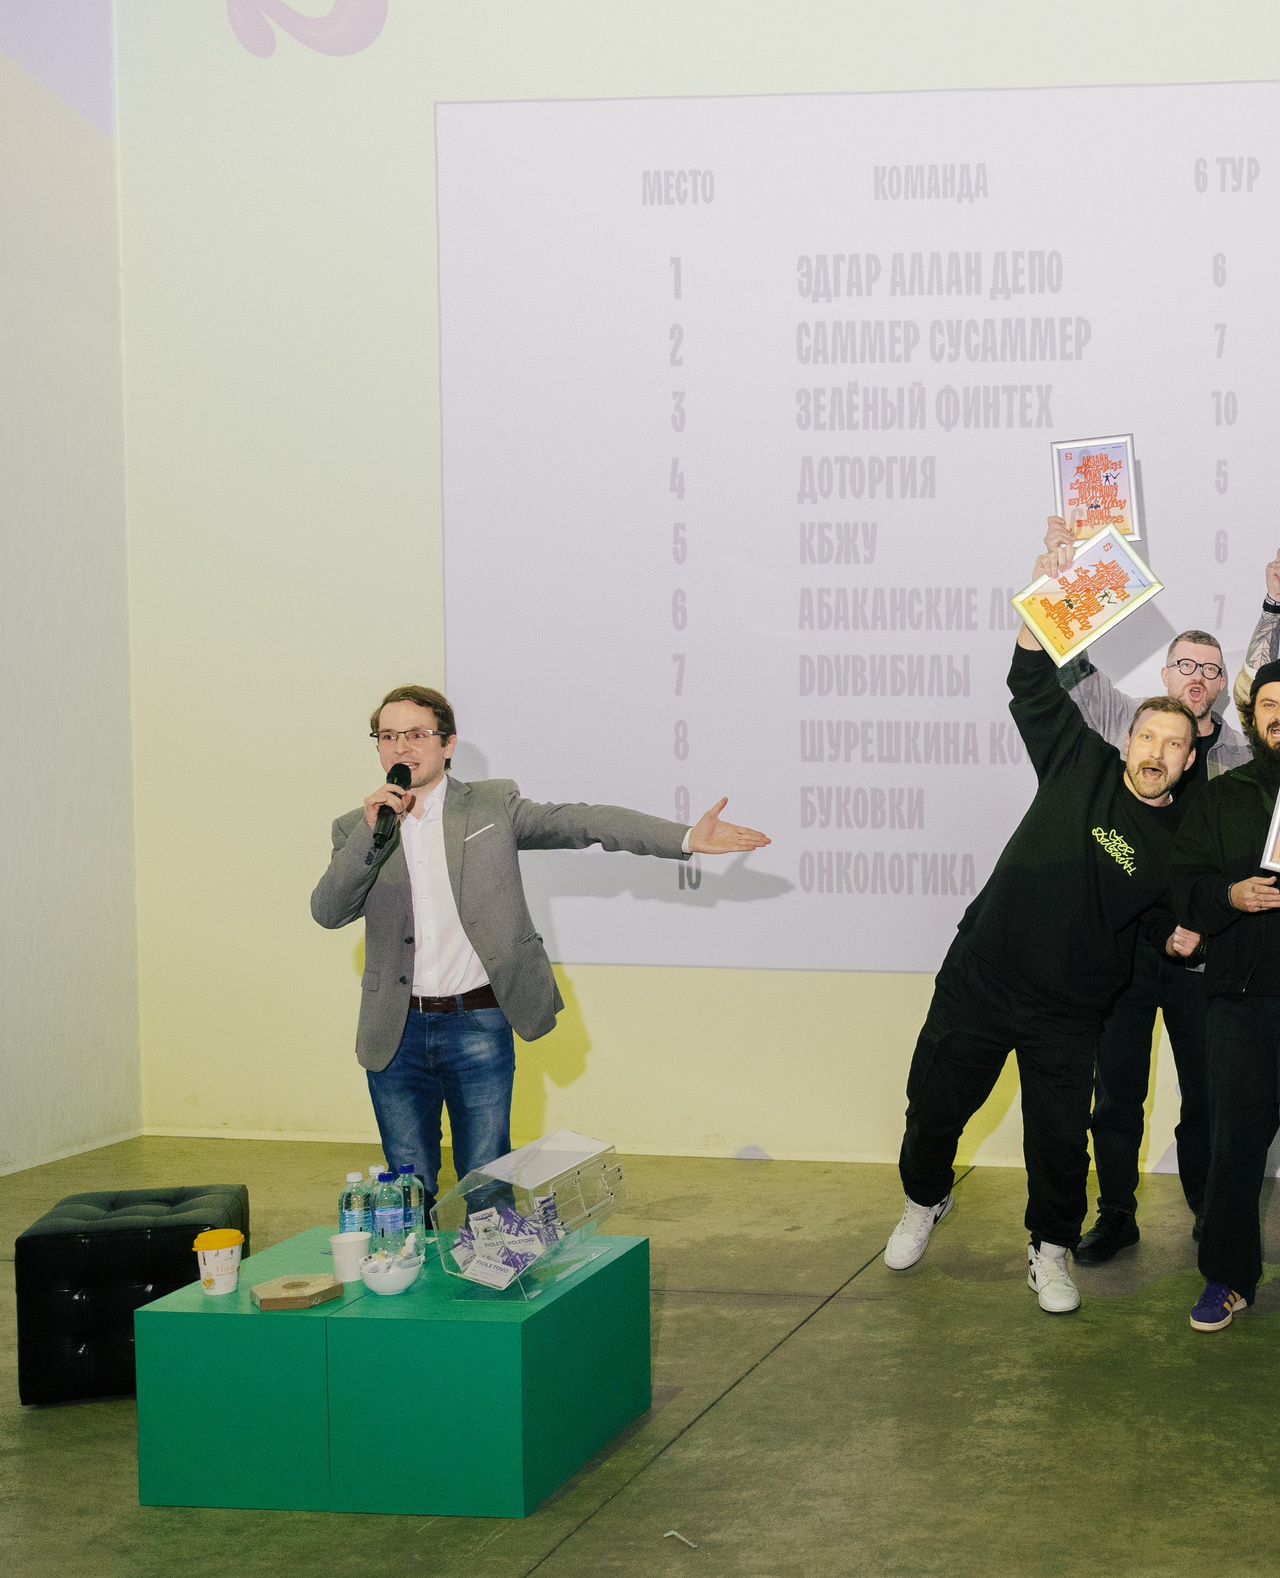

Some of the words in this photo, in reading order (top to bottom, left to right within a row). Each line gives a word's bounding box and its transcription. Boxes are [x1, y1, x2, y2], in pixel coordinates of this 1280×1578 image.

[642, 170, 714, 205] МЕСТО
[874, 163, 988, 203] КОМАНДА
[1194, 158, 1208, 193] 6
[1216, 157, 1260, 193] ТУР
[670, 257, 682, 300] 1
[797, 254, 882, 303] ЭДГАР
[890, 252, 982, 296] АЛЛАН
[990, 250, 1063, 300] ДЕПО
[1213, 253, 1226, 288] 6
[670, 324, 683, 367] 2
[796, 320, 920, 364] САММЕР
[930, 317, 1091, 363] СУСАММЕР
[1215, 323, 1226, 358] 7
[671, 391, 686, 433] 3
[796, 381, 926, 431] ЗЕЛЁНЫЙ
[935, 385, 1053, 432] ФИНТЕХ
[1212, 391, 1237, 426] 10
[669, 458, 685, 500] 4
[797, 456, 936, 505] ДОТОРГИЯ
[1215, 460, 1228, 495] 5
[673, 523, 687, 565] 5
[800, 523, 878, 565] КБЖУ
[1215, 530, 1228, 564] 6
[672, 589, 687, 631] 6
[799, 588, 978, 631] АБАКАНСКИЕ
[1214, 594, 1226, 629] 7
[673, 654, 686, 696] 7
[674, 720, 689, 761] 8
[800, 721, 980, 765] ШУРЕШКИНА
[675, 785, 690, 824] 9
[800, 786, 925, 830] БУКОВКИ
[678, 853, 701, 890] 10
[800, 852, 977, 897] ОНКОЛОГИКА
[507, 1237, 535, 1246] FIOLETOVO
[475, 1259, 509, 1274] FIOLETOVO
